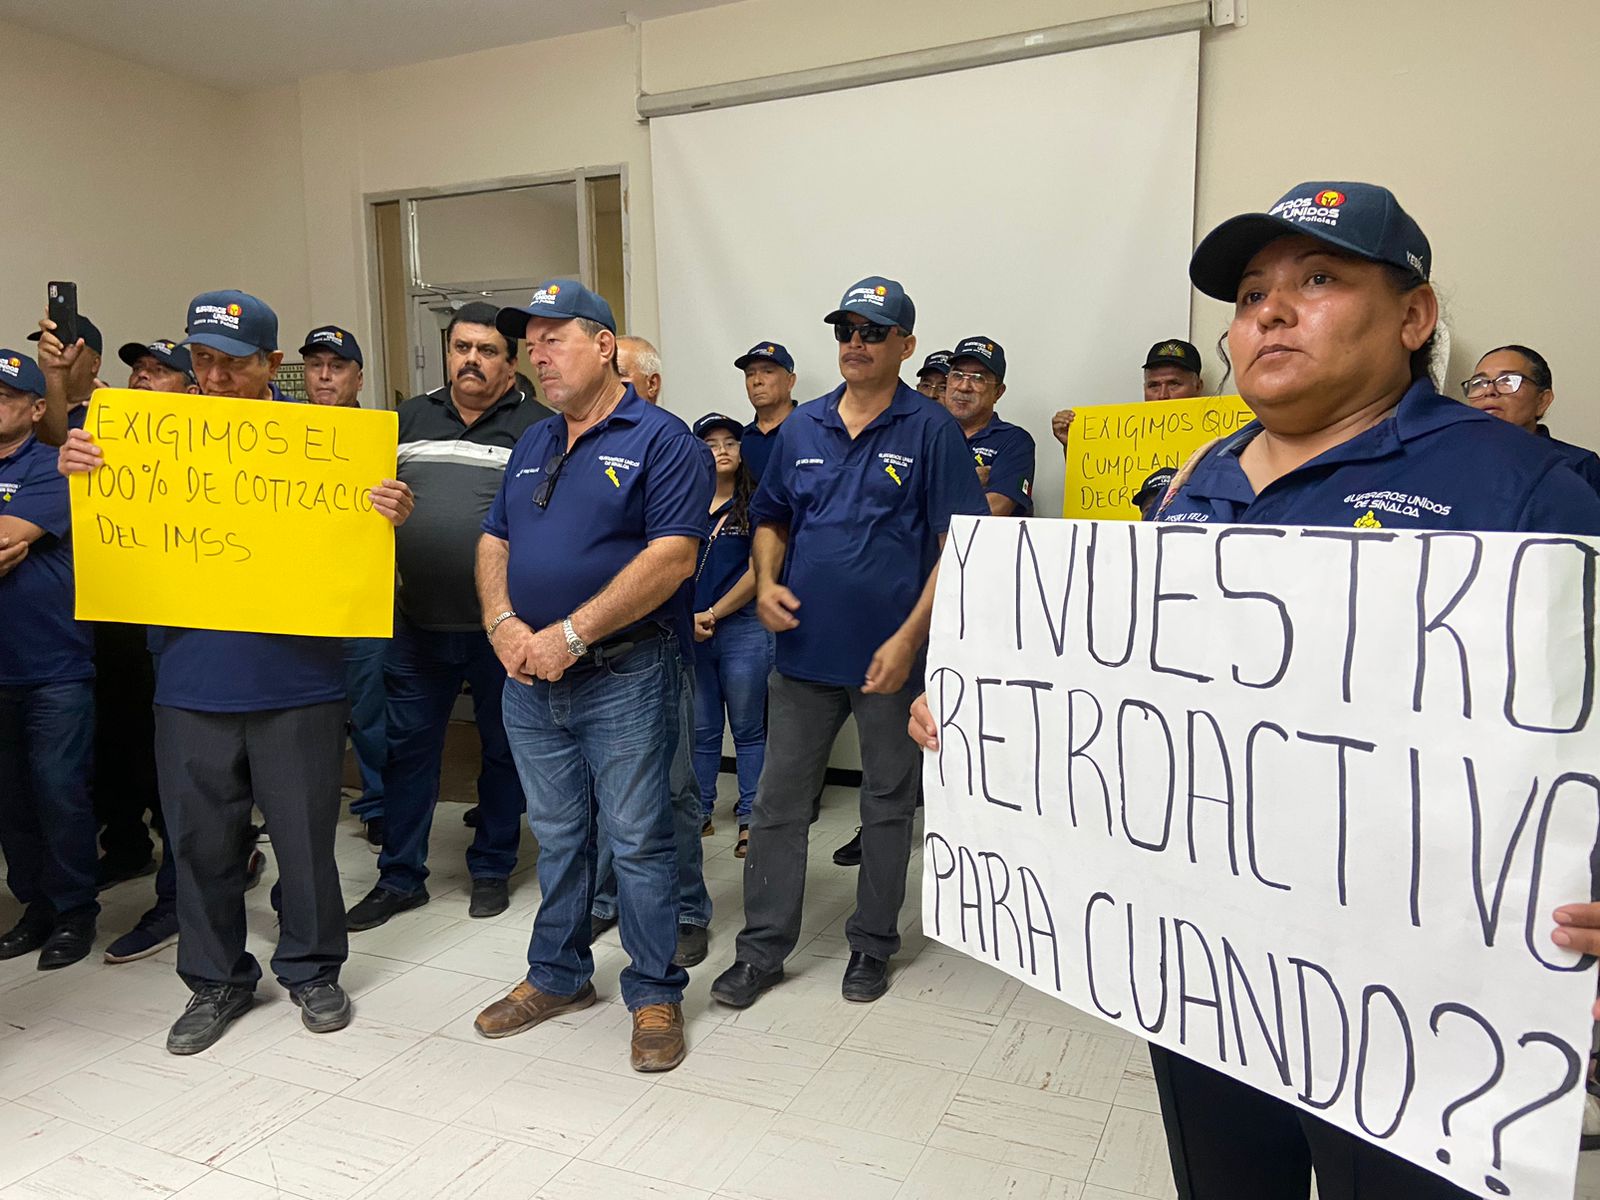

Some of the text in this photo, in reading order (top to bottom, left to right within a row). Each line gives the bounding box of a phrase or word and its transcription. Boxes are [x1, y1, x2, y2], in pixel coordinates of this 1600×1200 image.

[1283, 206, 1340, 219] UNIDOS
[97, 404, 349, 464] EXIGIMOS EL
[1083, 409, 1252, 450] EXIGIMOS QUE
[87, 460, 374, 514] 100% DE COTIZACIO
[1082, 451, 1179, 485] CUMPLAN
[1343, 491, 1452, 516] GUERREROS UNIDOS
[1353, 499, 1420, 518] DE SINALOA
[97, 513, 251, 563] DEL IMSS
[949, 520, 1600, 733] Y NUESTRO
[929, 667, 1600, 972] RETROACTIVO
[925, 832, 1063, 992] PARA
